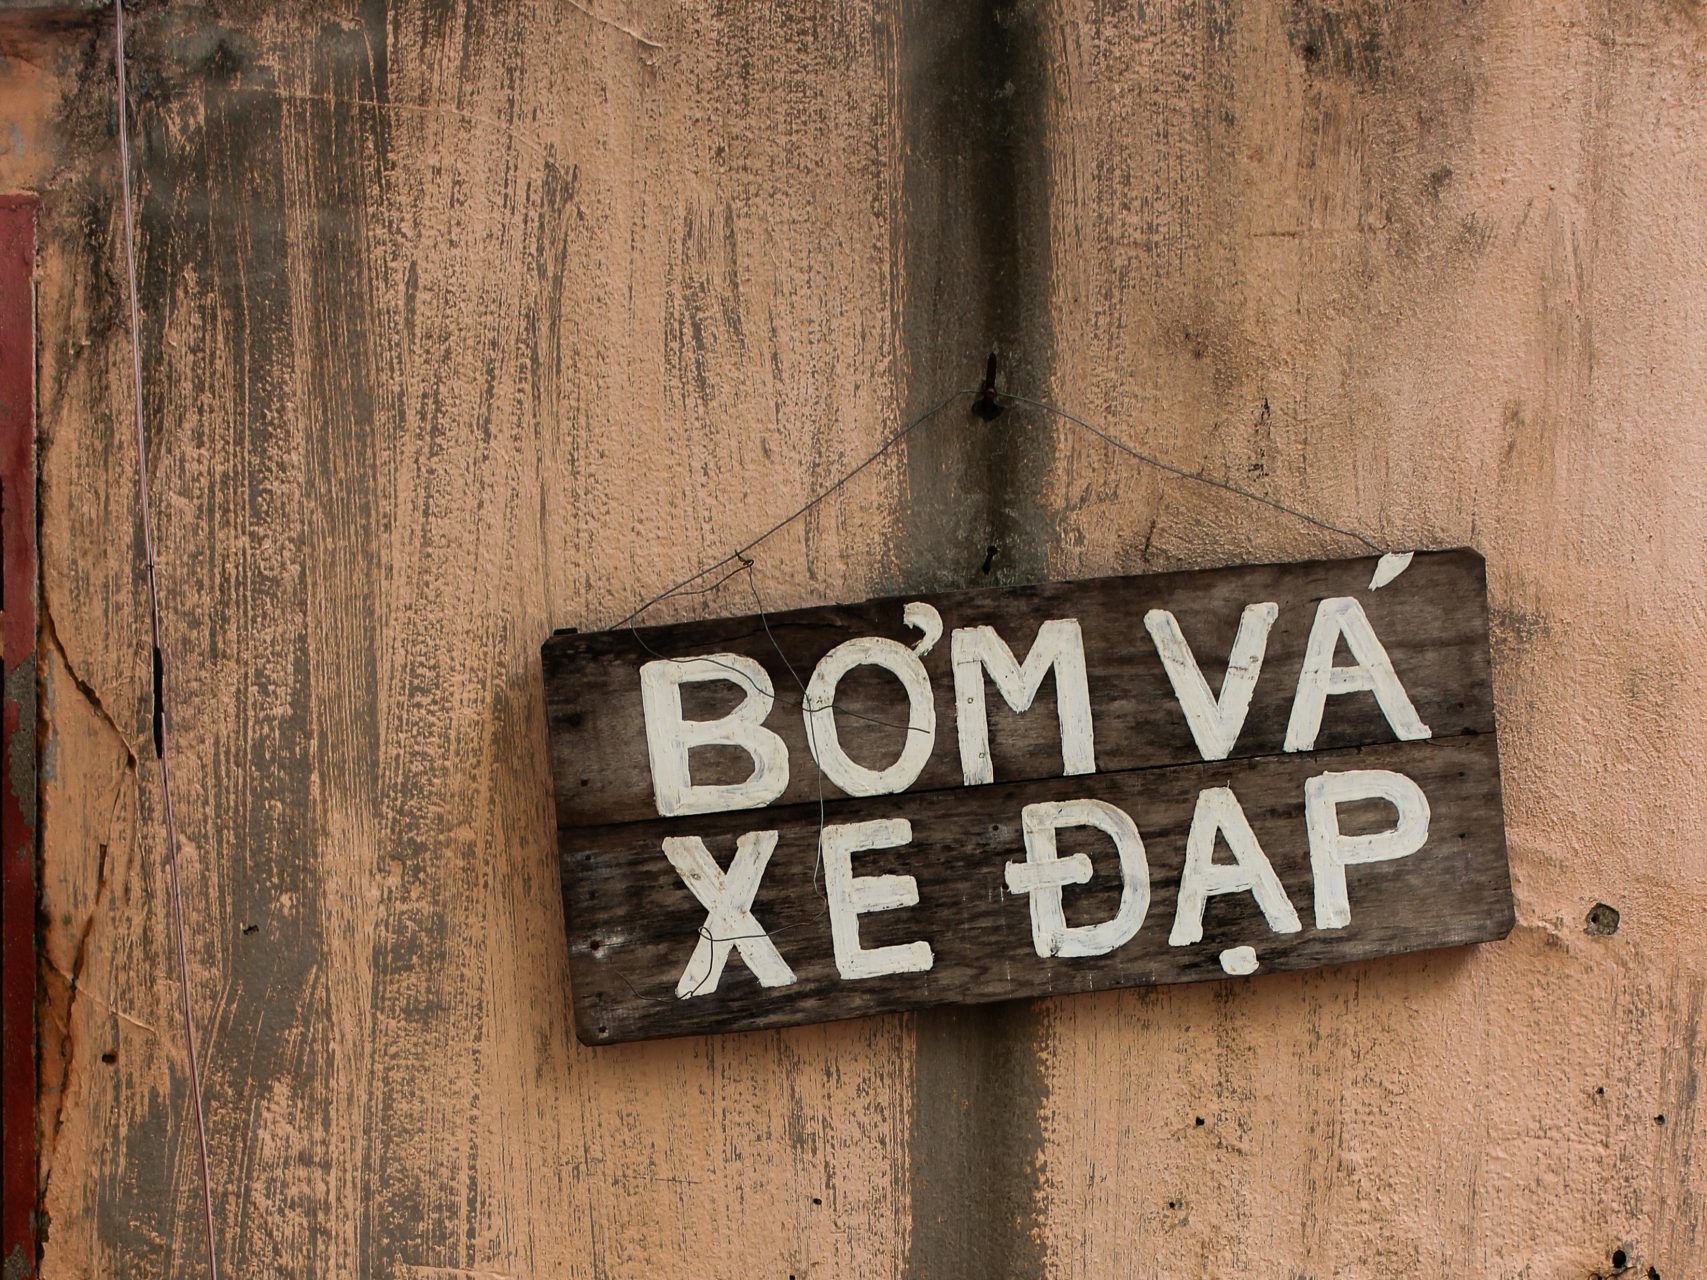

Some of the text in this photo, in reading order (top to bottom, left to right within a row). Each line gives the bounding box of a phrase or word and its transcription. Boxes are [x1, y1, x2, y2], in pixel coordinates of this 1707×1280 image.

[639, 551, 1432, 817] BƠM VÁ
[661, 769, 1431, 999] XE ĐẠP
